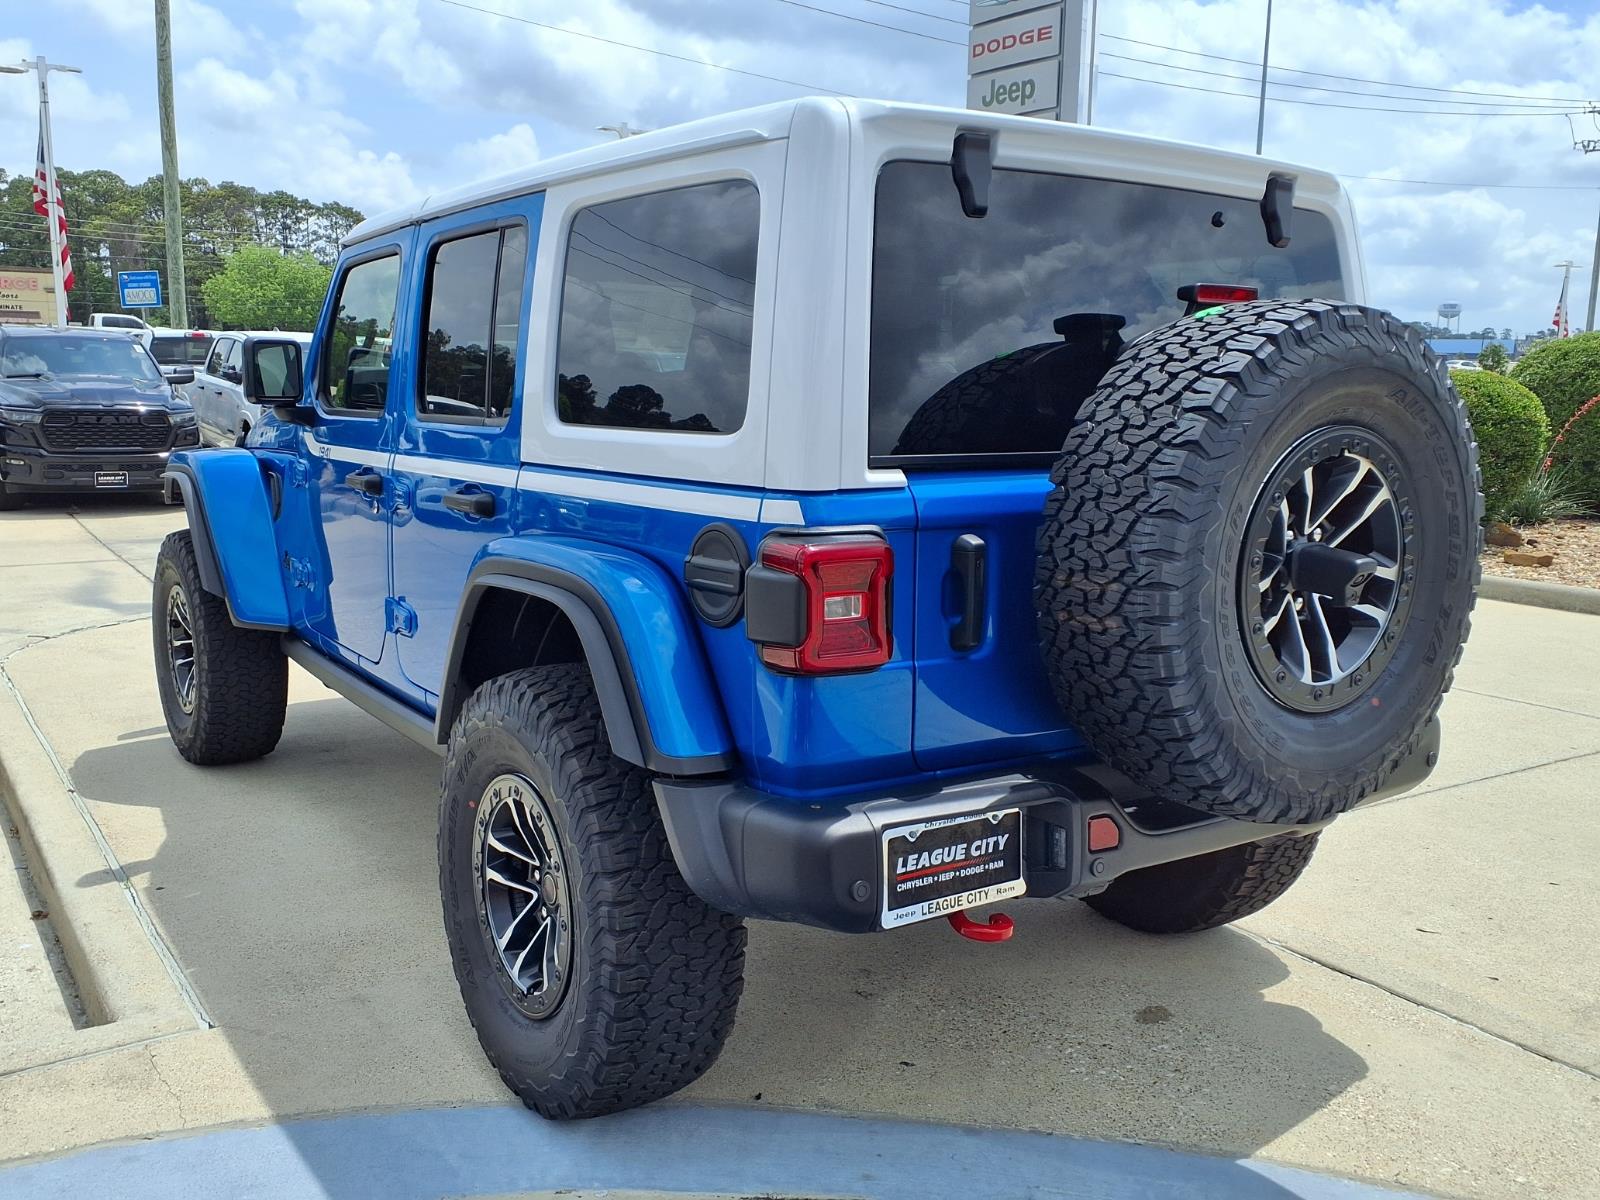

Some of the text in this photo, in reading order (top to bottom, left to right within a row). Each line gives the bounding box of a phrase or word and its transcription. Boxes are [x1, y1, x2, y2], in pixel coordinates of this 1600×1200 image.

[972, 25, 1053, 58] DODGE
[981, 78, 1035, 107] Jeep
[77, 415, 138, 424] RAM
[896, 833, 1009, 874] LEAGUE CITY
[896, 859, 1004, 892] CHRYSLER JEEP DODGE RAM
[893, 885, 1015, 921] Jeep LEAGUE CITY Ram
